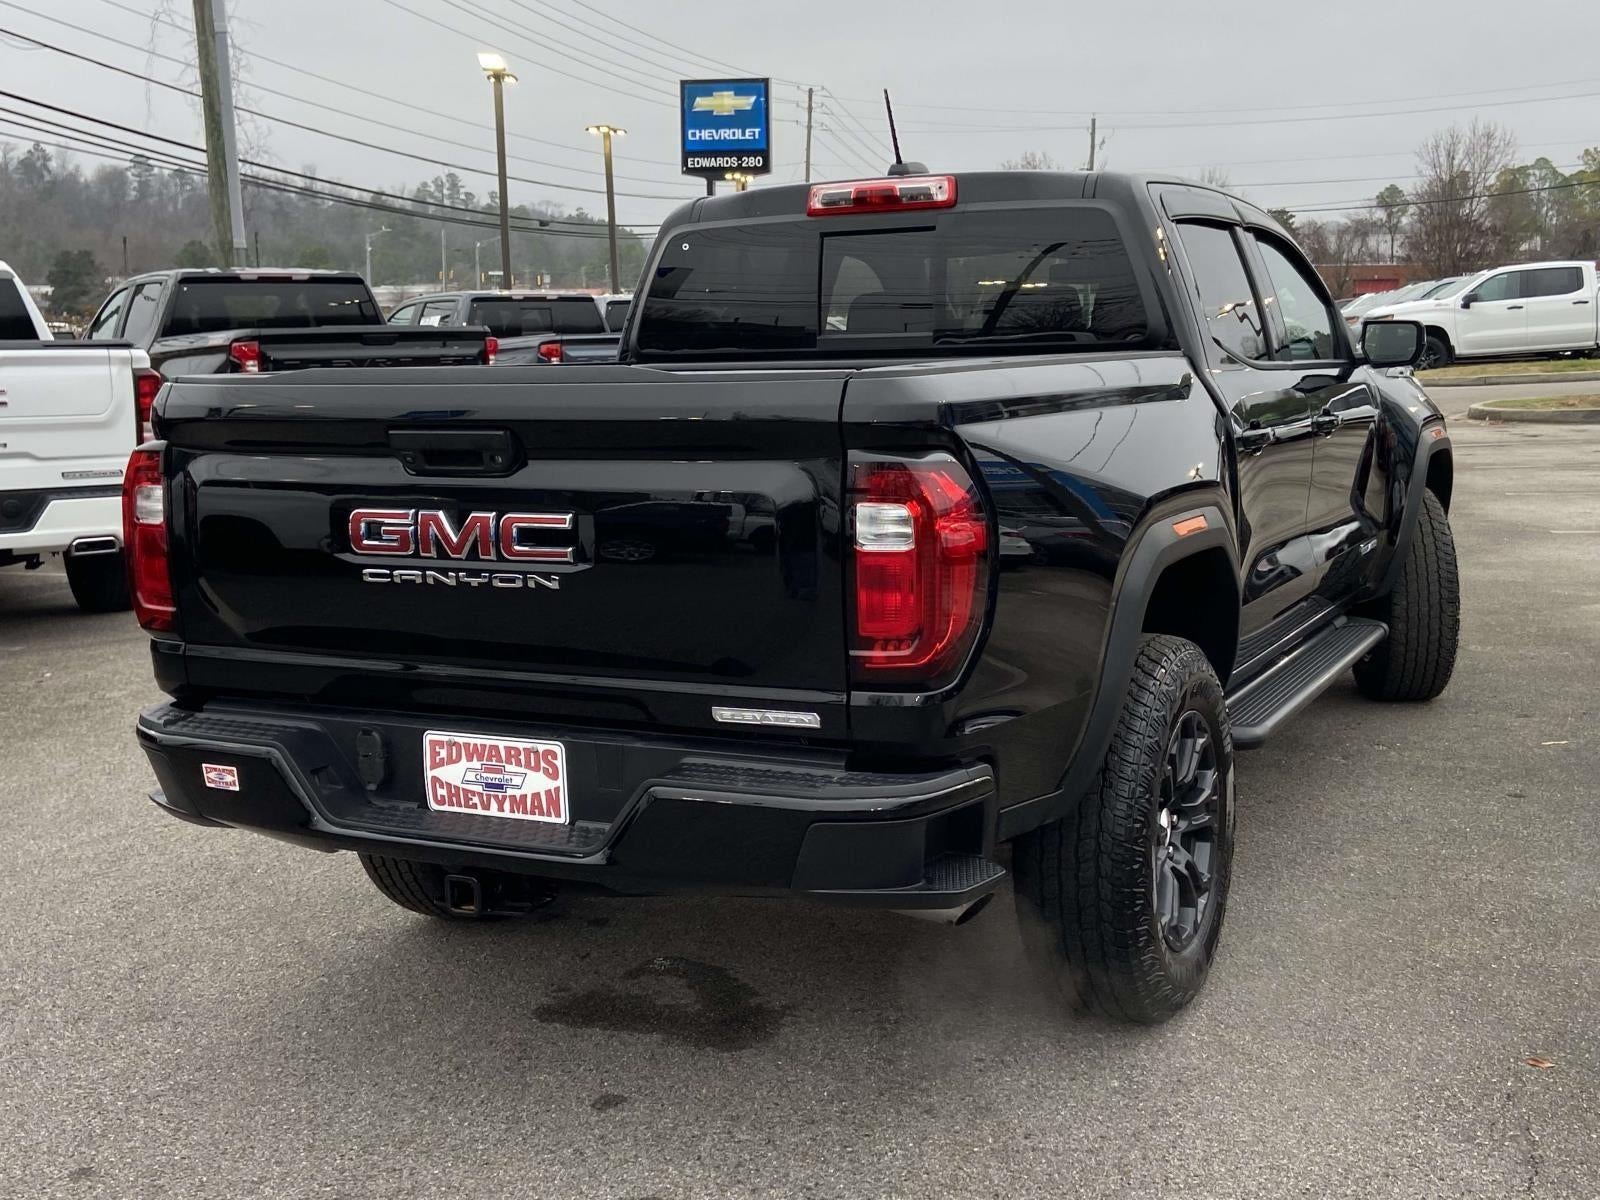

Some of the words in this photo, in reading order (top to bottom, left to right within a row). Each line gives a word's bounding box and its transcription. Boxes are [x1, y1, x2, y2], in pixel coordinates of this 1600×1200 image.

[688, 128, 761, 141] CHEVROLET
[349, 508, 575, 562] GMC
[361, 568, 560, 590] CANYON
[428, 739, 560, 781] EDWARDS
[474, 772, 514, 784] Chevrolet
[430, 775, 562, 818] CHEVYMAN
